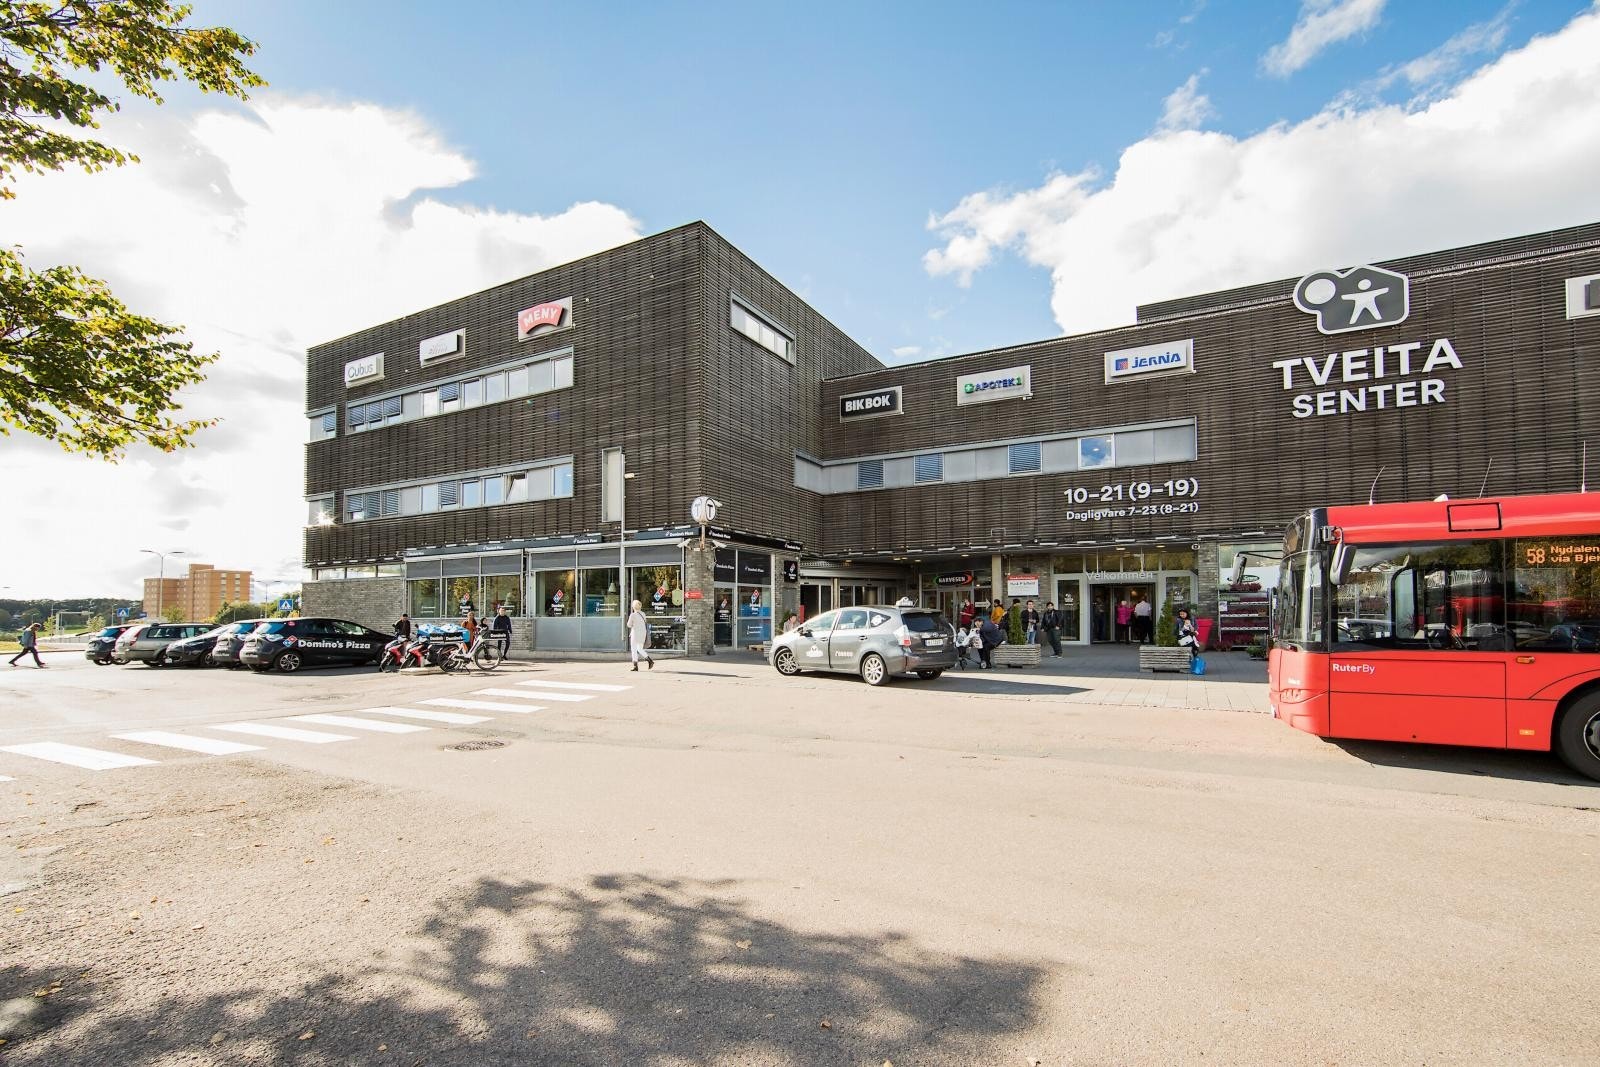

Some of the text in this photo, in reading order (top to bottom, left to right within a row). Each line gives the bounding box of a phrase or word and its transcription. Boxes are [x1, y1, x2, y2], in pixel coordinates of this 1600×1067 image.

[523, 307, 558, 327] MENY
[348, 363, 373, 379] Cubus
[1273, 338, 1463, 390] TVEITA
[1292, 379, 1446, 418] SENTER
[1063, 477, 1199, 504] 10-21 (9-19)
[1066, 502, 1199, 522] Dagligvare 7-23 (8-21)
[1526, 548, 1546, 564] 58
[1550, 545, 1600, 555] Nydalen
[1550, 554, 1571, 562] via
[1086, 571, 1153, 580] Velkommen
[298, 640, 371, 649] Domino's Pizza
[1333, 663, 1375, 674] RuterBy
